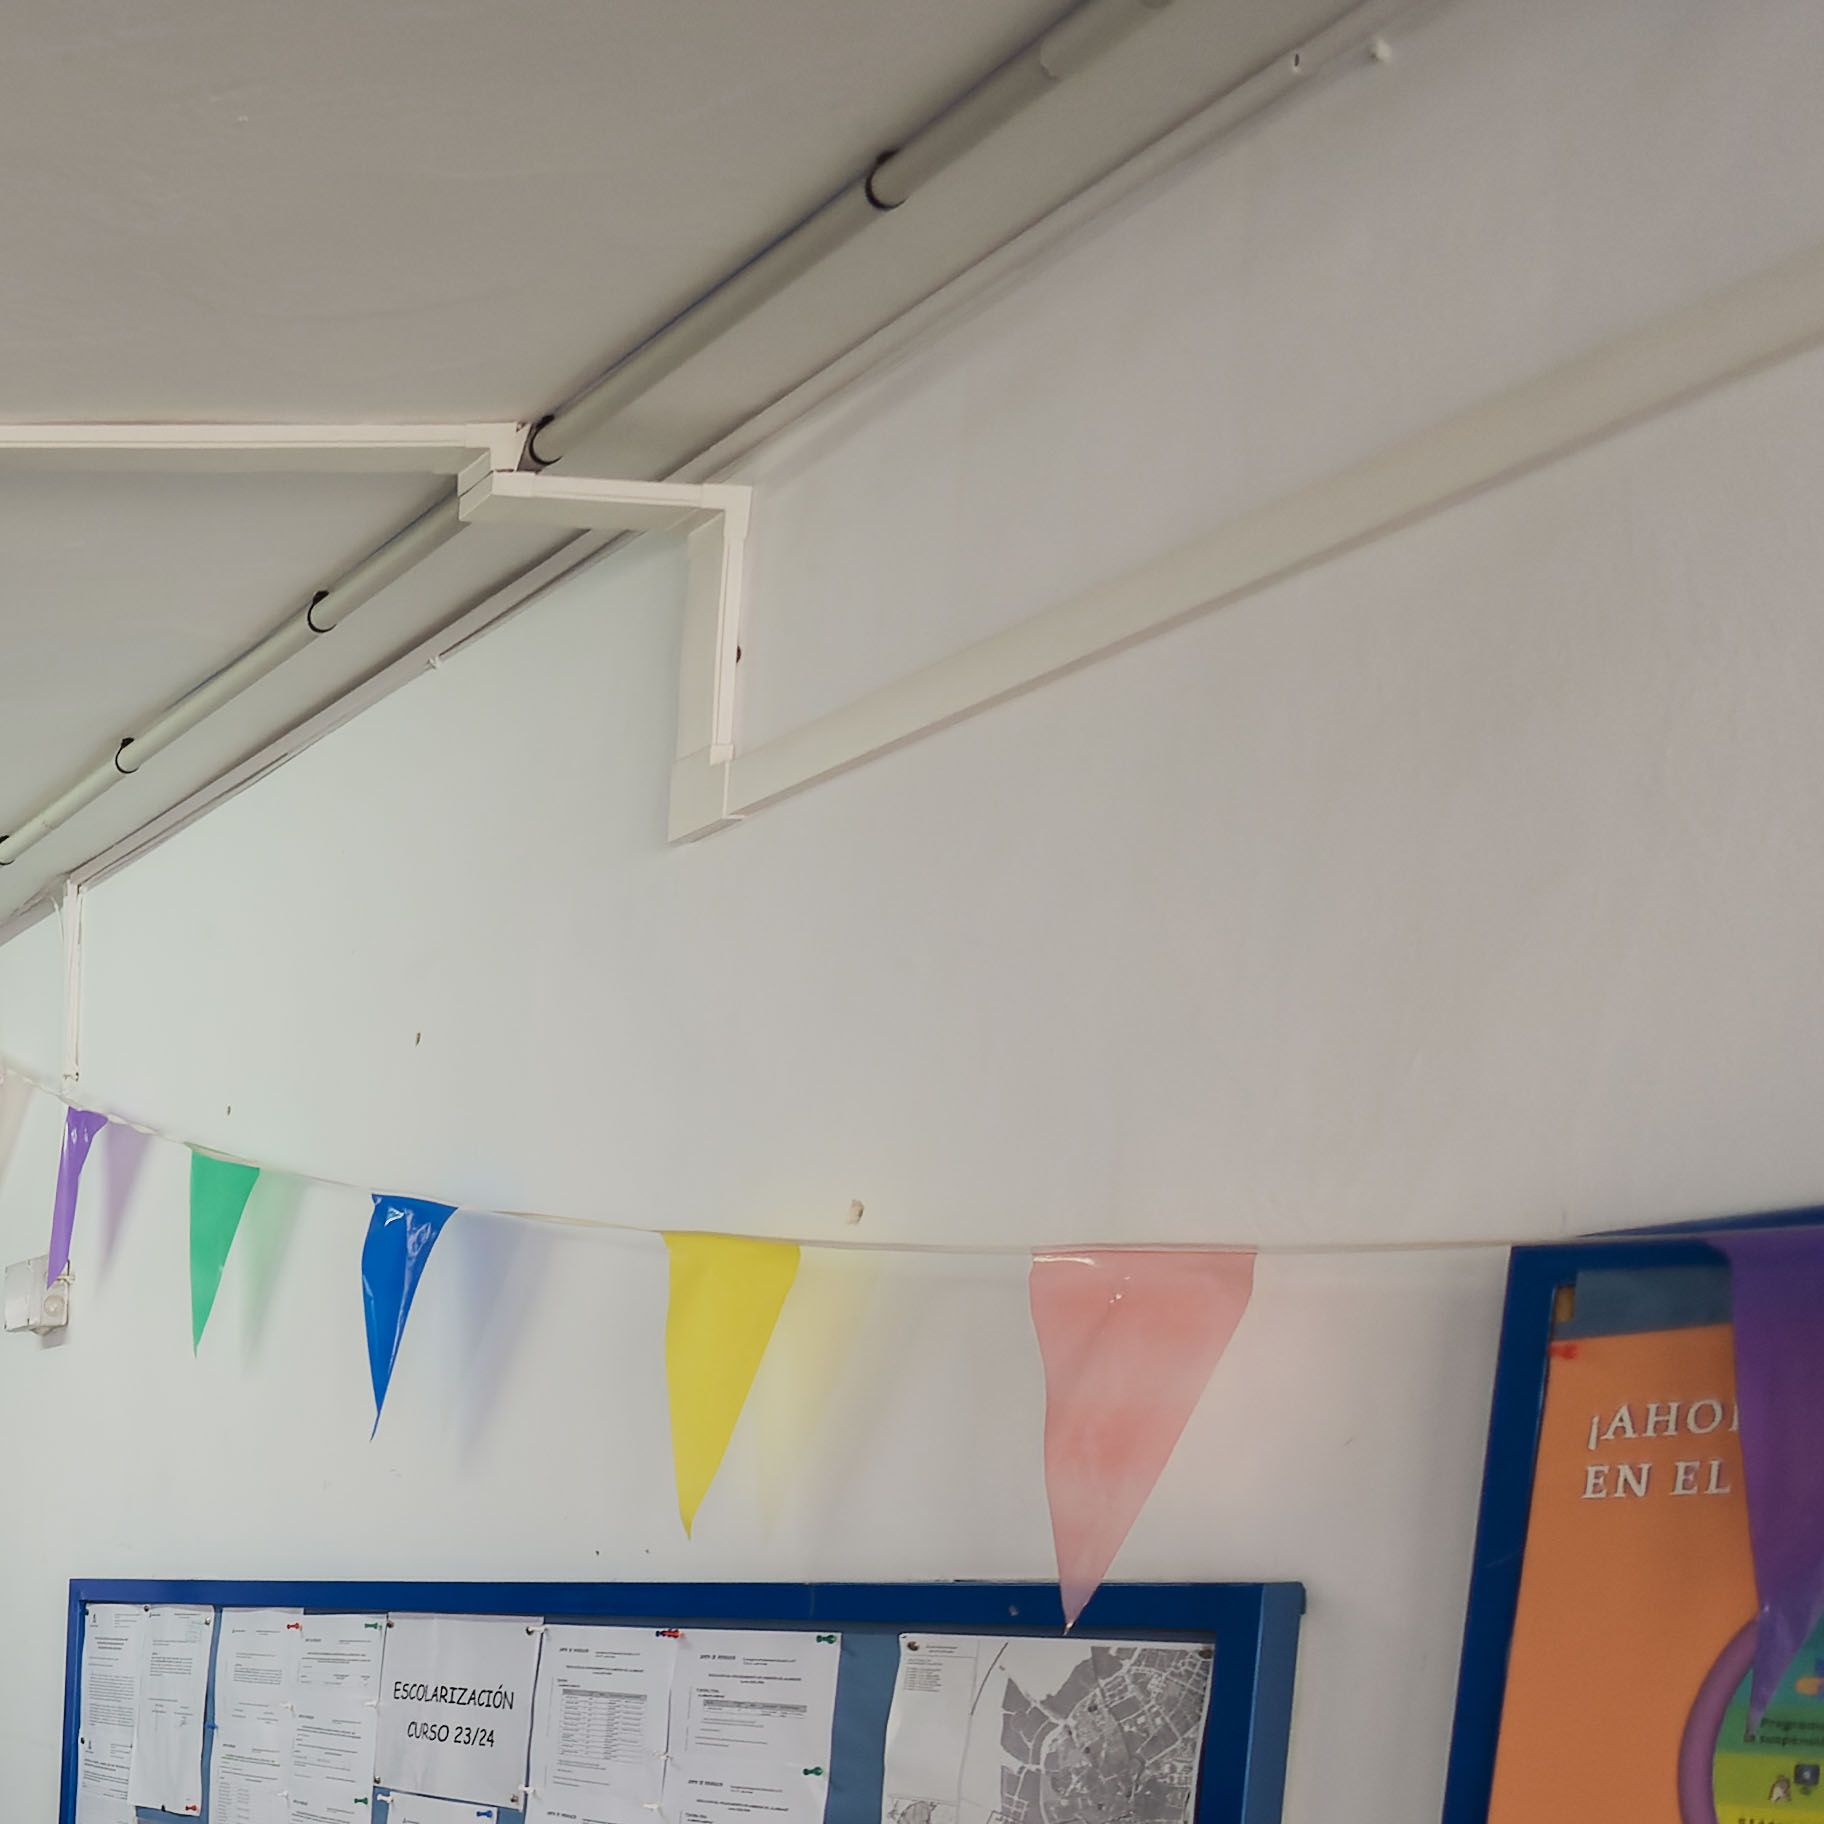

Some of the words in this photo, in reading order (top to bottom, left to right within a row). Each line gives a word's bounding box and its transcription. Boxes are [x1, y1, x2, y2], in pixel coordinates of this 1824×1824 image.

[1581, 1463, 1651, 1499] EN
[1669, 1460, 1731, 1496] EL
[393, 1681, 514, 1710] ESCOLARIZACIÓN
[407, 1721, 450, 1742] CURSO
[453, 1726, 494, 1748] 23/24
